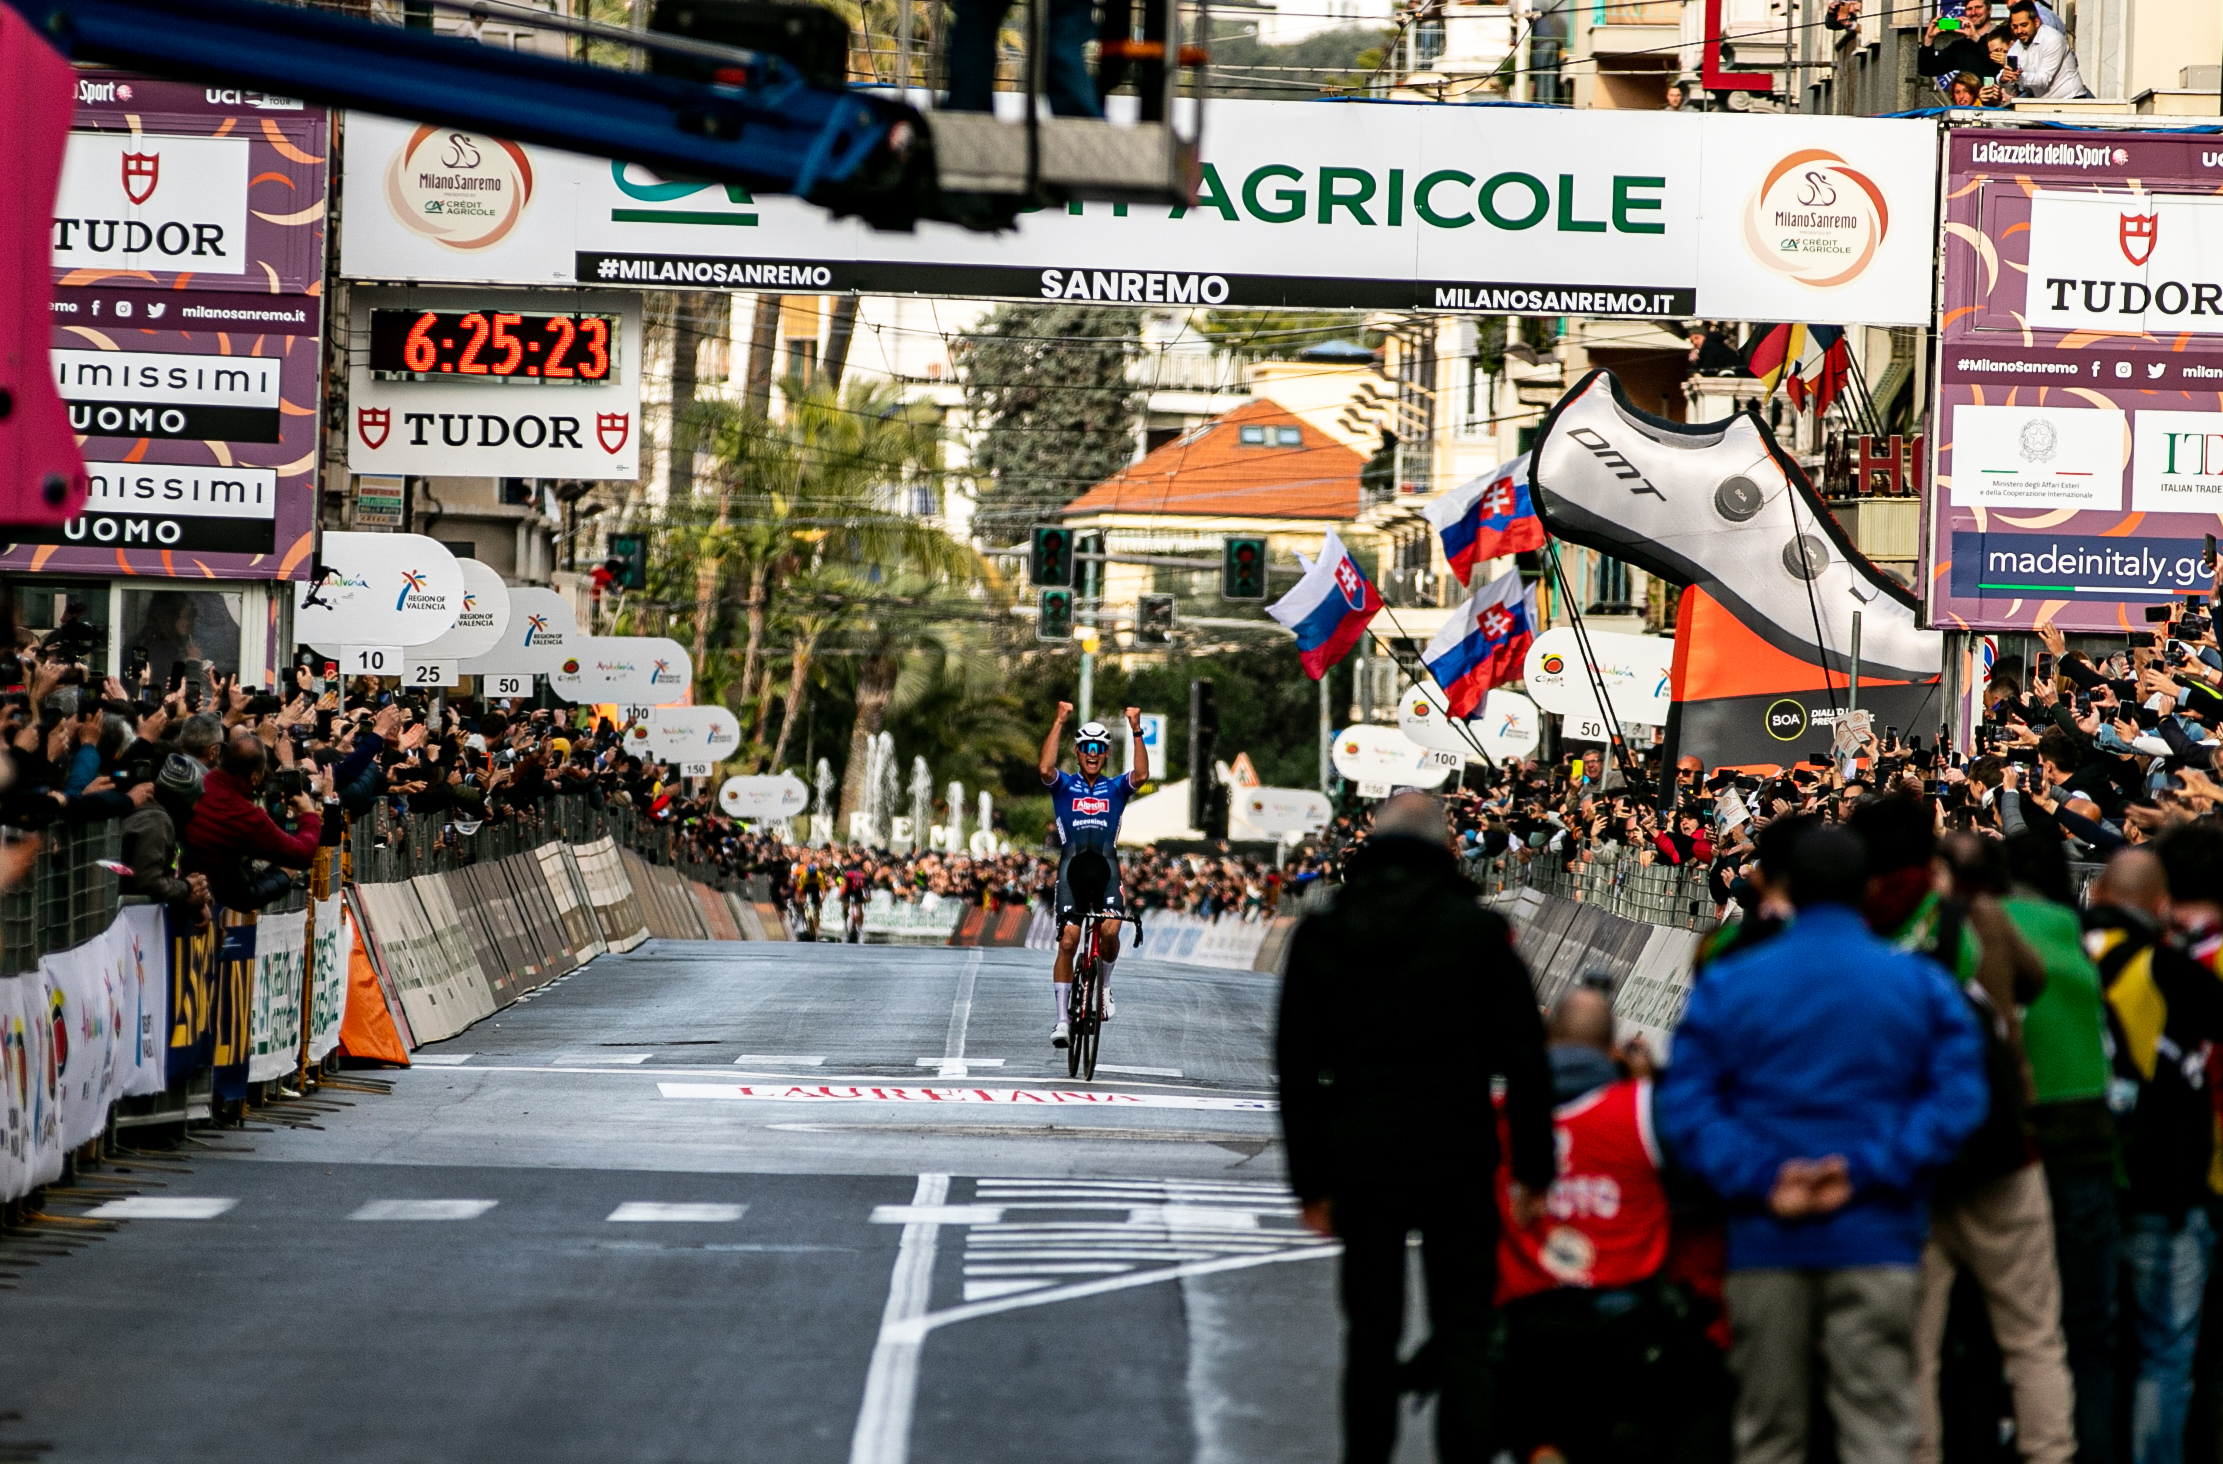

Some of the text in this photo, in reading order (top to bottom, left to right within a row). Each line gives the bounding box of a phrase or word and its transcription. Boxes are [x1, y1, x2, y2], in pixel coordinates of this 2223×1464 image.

[79, 80, 116, 105] Sport
[206, 88, 241, 104] UCI
[2075, 144, 2111, 169] Sport
[419, 172, 502, 191] MilanoSanremo
[446, 200, 482, 208] CRÉDIT
[1168, 160, 1666, 236] AGRICOLE
[446, 208, 496, 216] AGRICOLE
[1775, 210, 1857, 229] MilanoSanremo
[52, 217, 226, 257] TUDOR
[1802, 238, 1838, 246] CRÉDIT
[1802, 245, 1852, 254] AGRICOLE
[598, 258, 832, 287] #MILANOSANREMO
[1041, 268, 1230, 304] SANREMO
[1435, 287, 1674, 314] MILANOSANREMO.IT
[2046, 277, 2223, 315] TUDOR
[182, 305, 306, 323] milanosanremo.it
[404, 312, 609, 379] 6:25:23
[1957, 359, 2079, 375] #MilanoSanremo
[59, 362, 267, 393] imissimi
[68, 405, 186, 433] UOMO
[404, 413, 583, 450] TUDOR
[86, 474, 263, 504] missimi
[1992, 480, 2024, 488] Ministero
[2025, 481, 2041, 490] degli
[2003, 490, 2047, 498] Cooperazione
[2161, 483, 2223, 494] ITALIAN TRADE
[64, 516, 182, 543] UOMO
[1988, 543, 2217, 586] madeinitaly.go
[406, 602, 446, 611] VALENCIA
[408, 595, 436, 603] REGION
[459, 613, 484, 621] REGION
[358, 651, 384, 670] 10
[416, 665, 441, 683] 25
[499, 678, 520, 693] 50
[1580, 721, 1601, 737] 50
[1772, 714, 1801, 727] BOA
[1434, 752, 1457, 766] 100
[686, 764, 706, 775] 150
